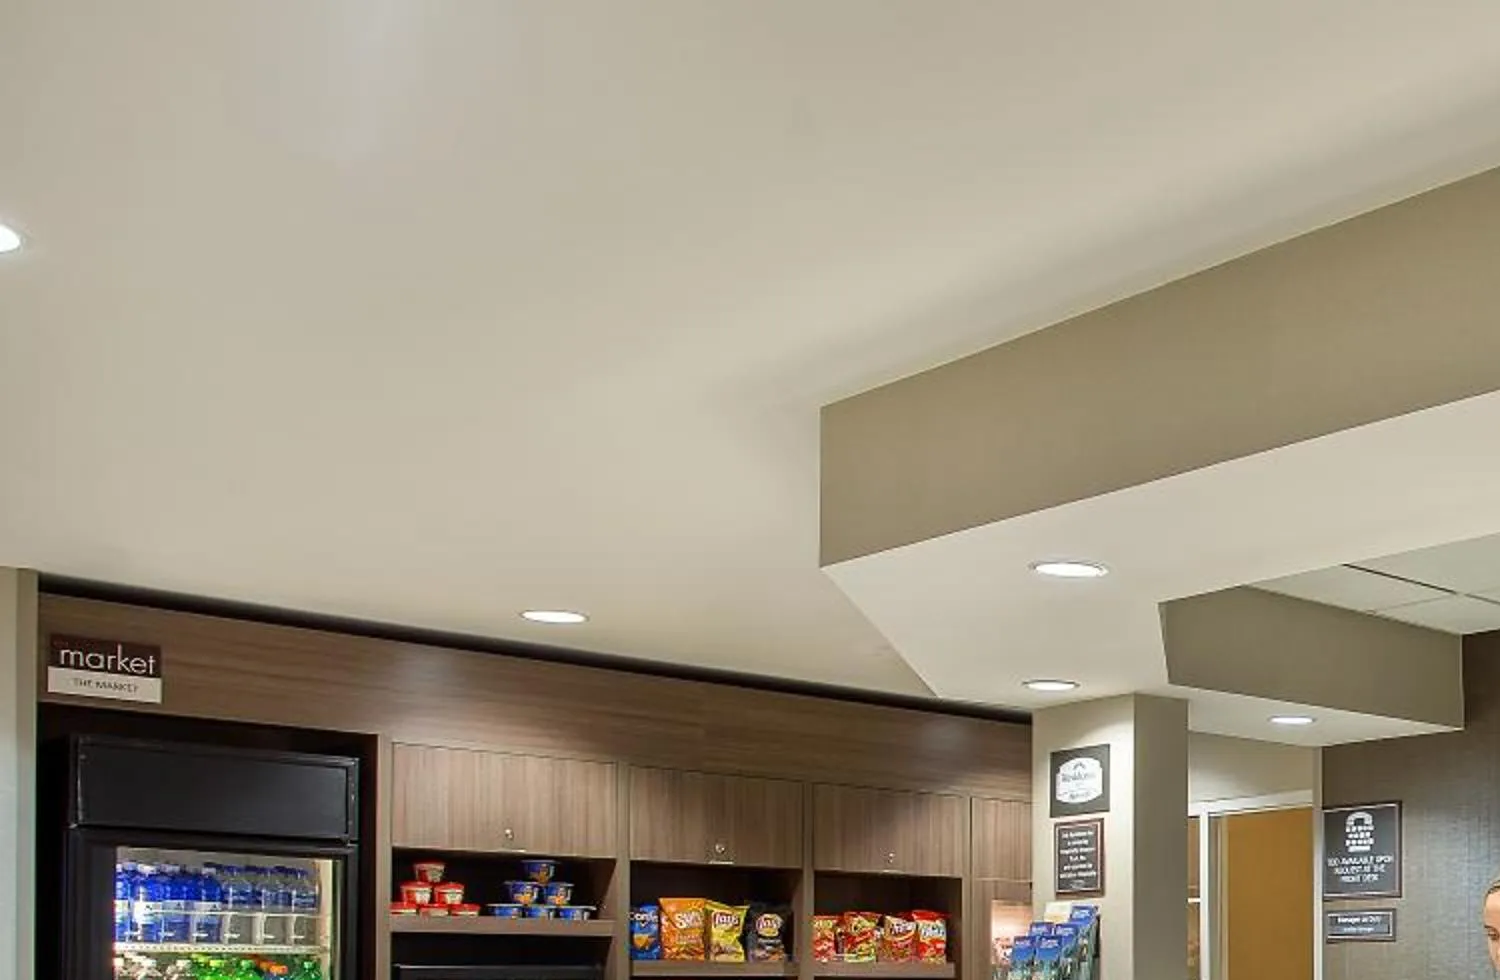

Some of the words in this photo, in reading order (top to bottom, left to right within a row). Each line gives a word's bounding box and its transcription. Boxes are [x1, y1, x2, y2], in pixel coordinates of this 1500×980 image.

[60, 643, 156, 675] market
[74, 678, 93, 687] THE
[96, 681, 138, 693] MARKET
